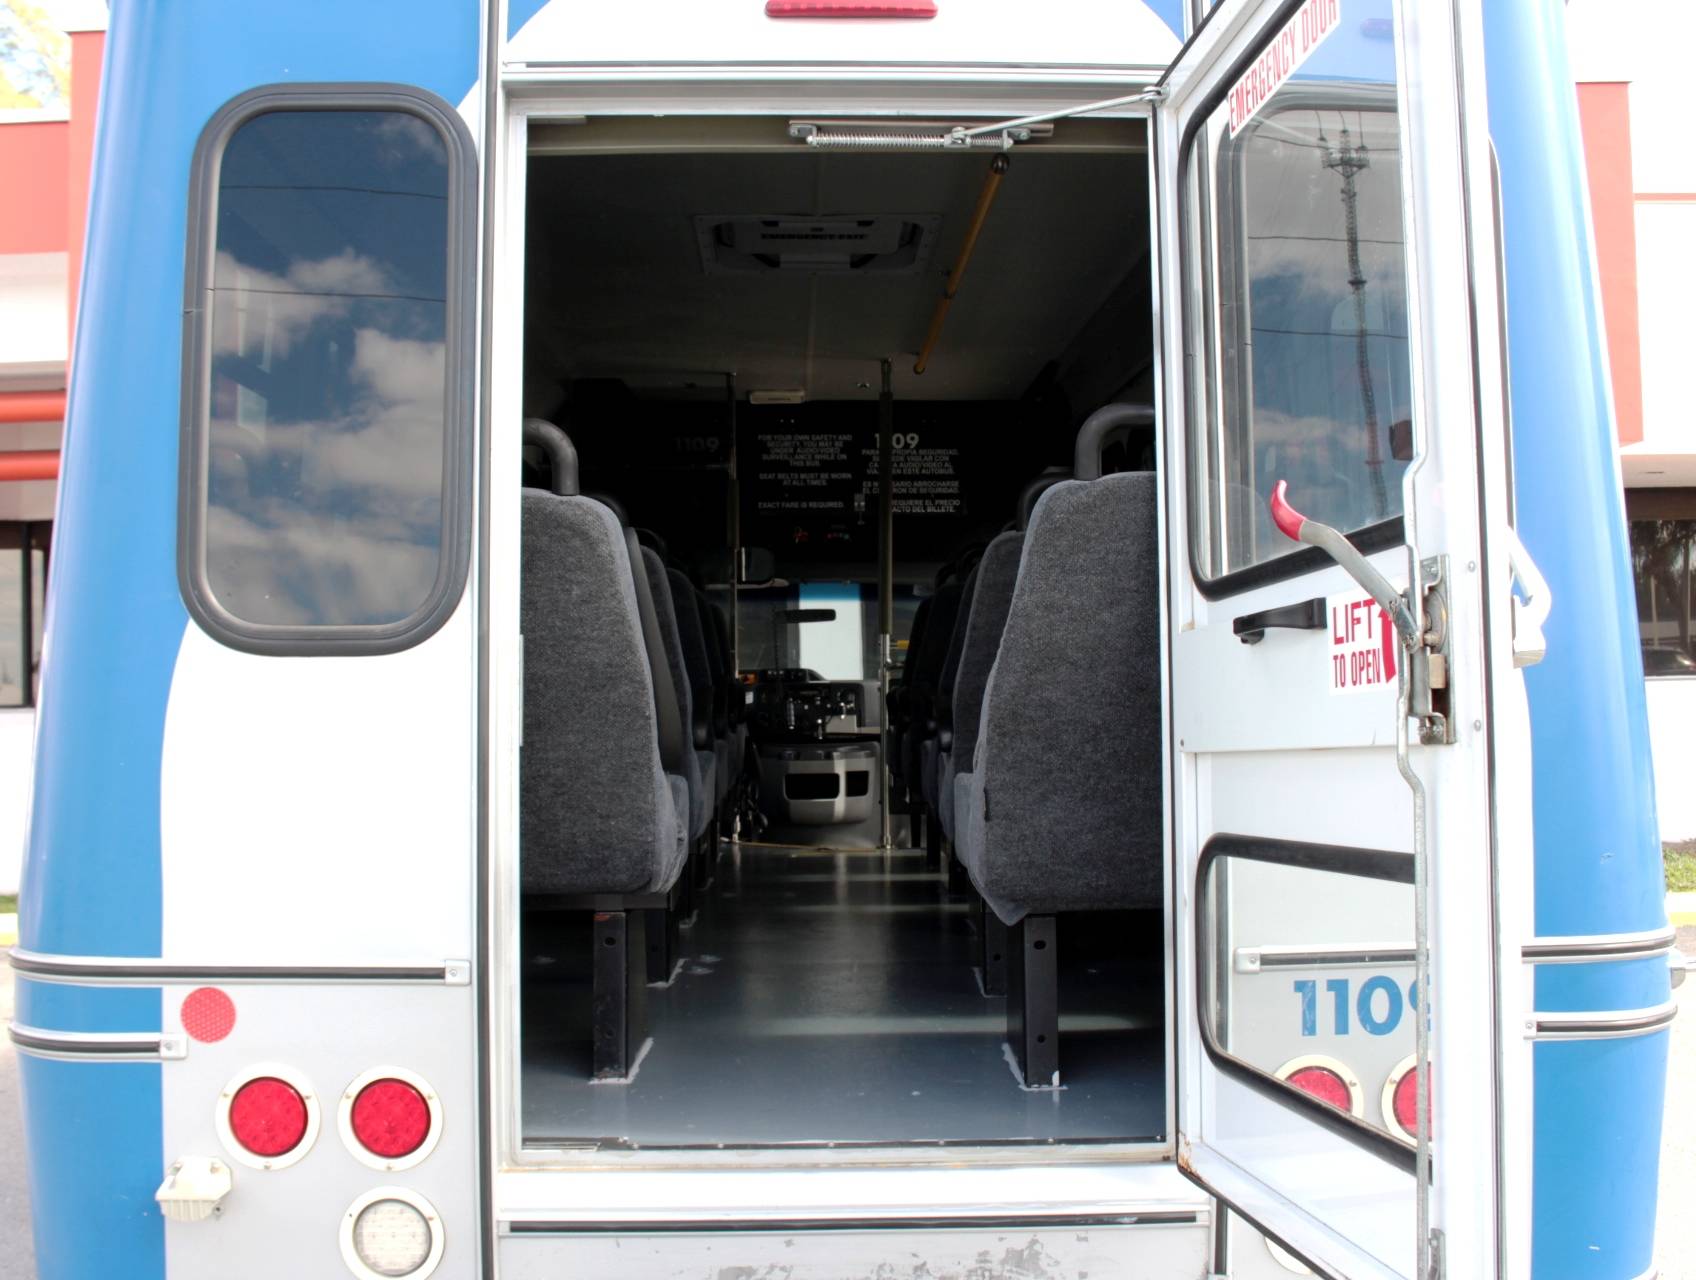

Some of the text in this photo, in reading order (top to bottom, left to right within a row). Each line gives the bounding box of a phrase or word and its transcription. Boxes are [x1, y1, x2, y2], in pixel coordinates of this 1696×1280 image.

[1228, 19, 1296, 133] EMERGENCY
[874, 433, 919, 449] 109
[759, 472, 852, 480] SEAT BELTS MUST BE WORN
[758, 501, 780, 509] EXACT
[781, 501, 799, 509] FARE
[800, 501, 808, 509] IS
[891, 505, 911, 513] ACTO
[912, 505, 925, 513] DEL
[1332, 598, 1376, 645] LIFT
[1333, 647, 1382, 689] TO OPEN
[1294, 975, 1431, 1036] 110
